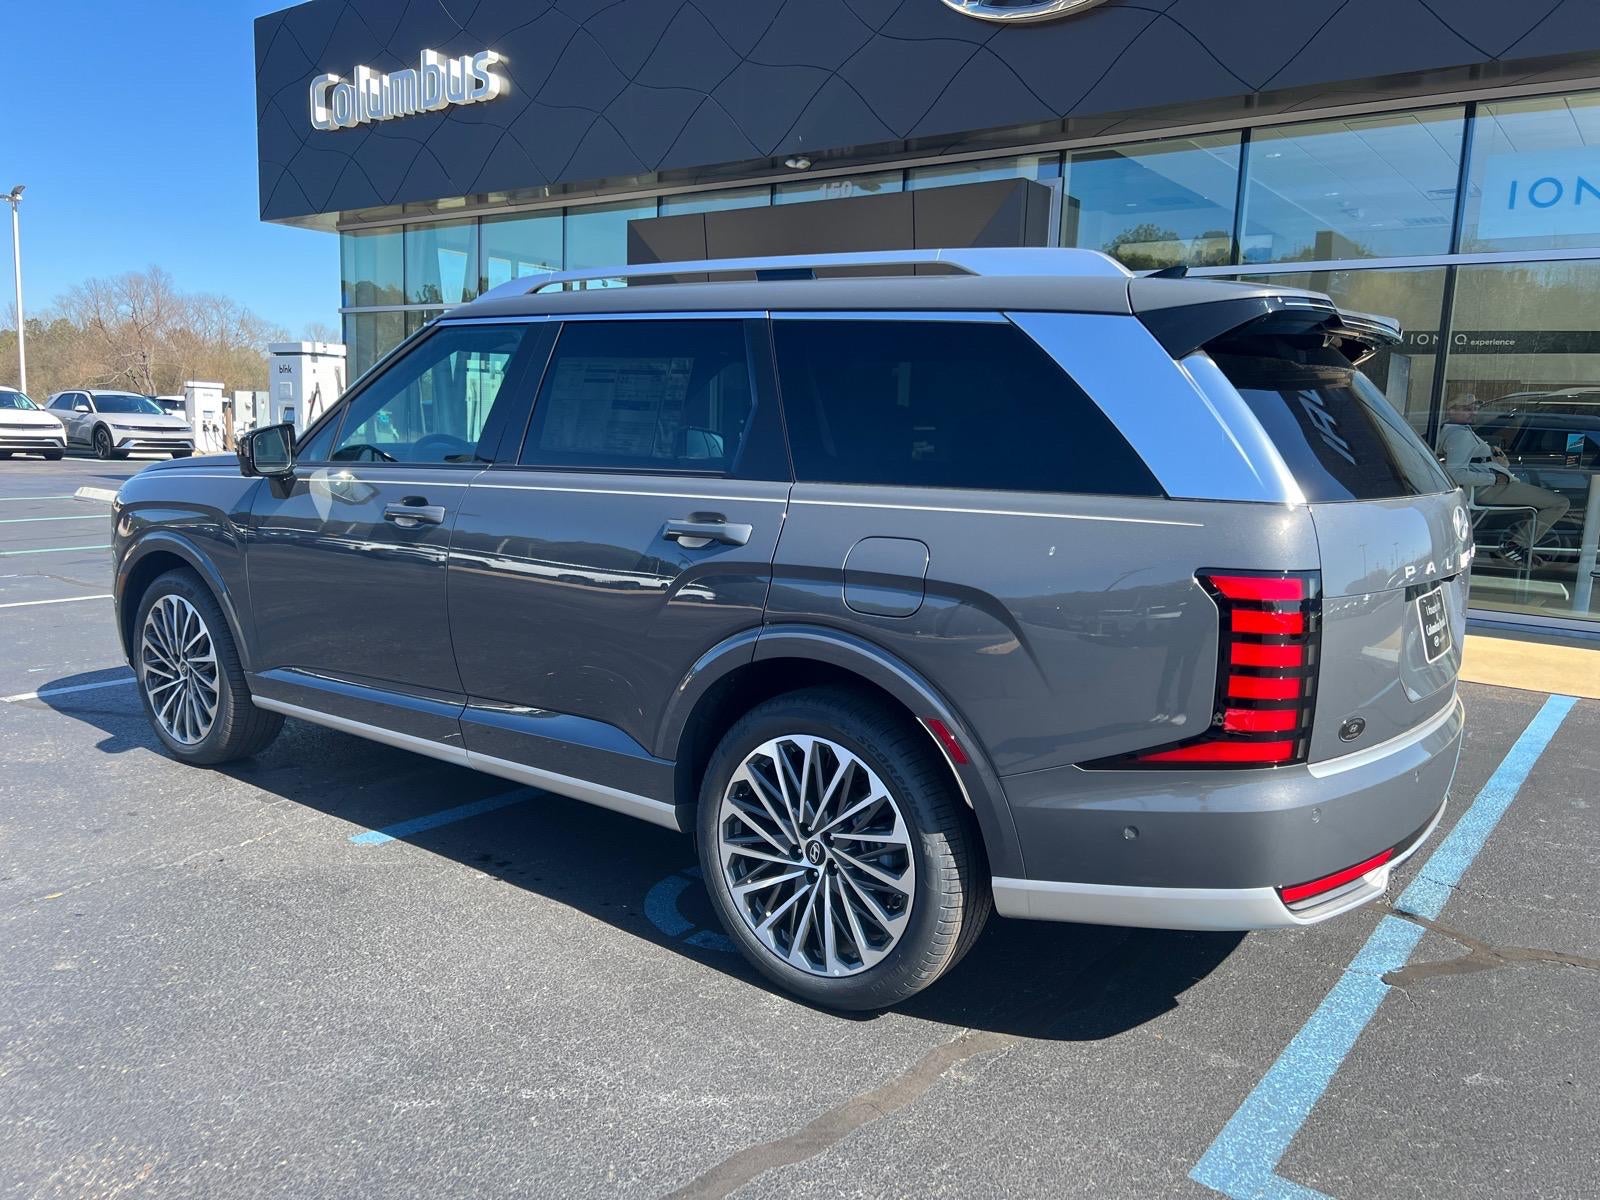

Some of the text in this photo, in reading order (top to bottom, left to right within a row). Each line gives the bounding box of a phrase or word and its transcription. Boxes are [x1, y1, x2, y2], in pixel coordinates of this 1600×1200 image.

[309, 48, 500, 131] Columbus
[1410, 333, 1516, 347] IONQ experience
[279, 364, 293, 374] blink
